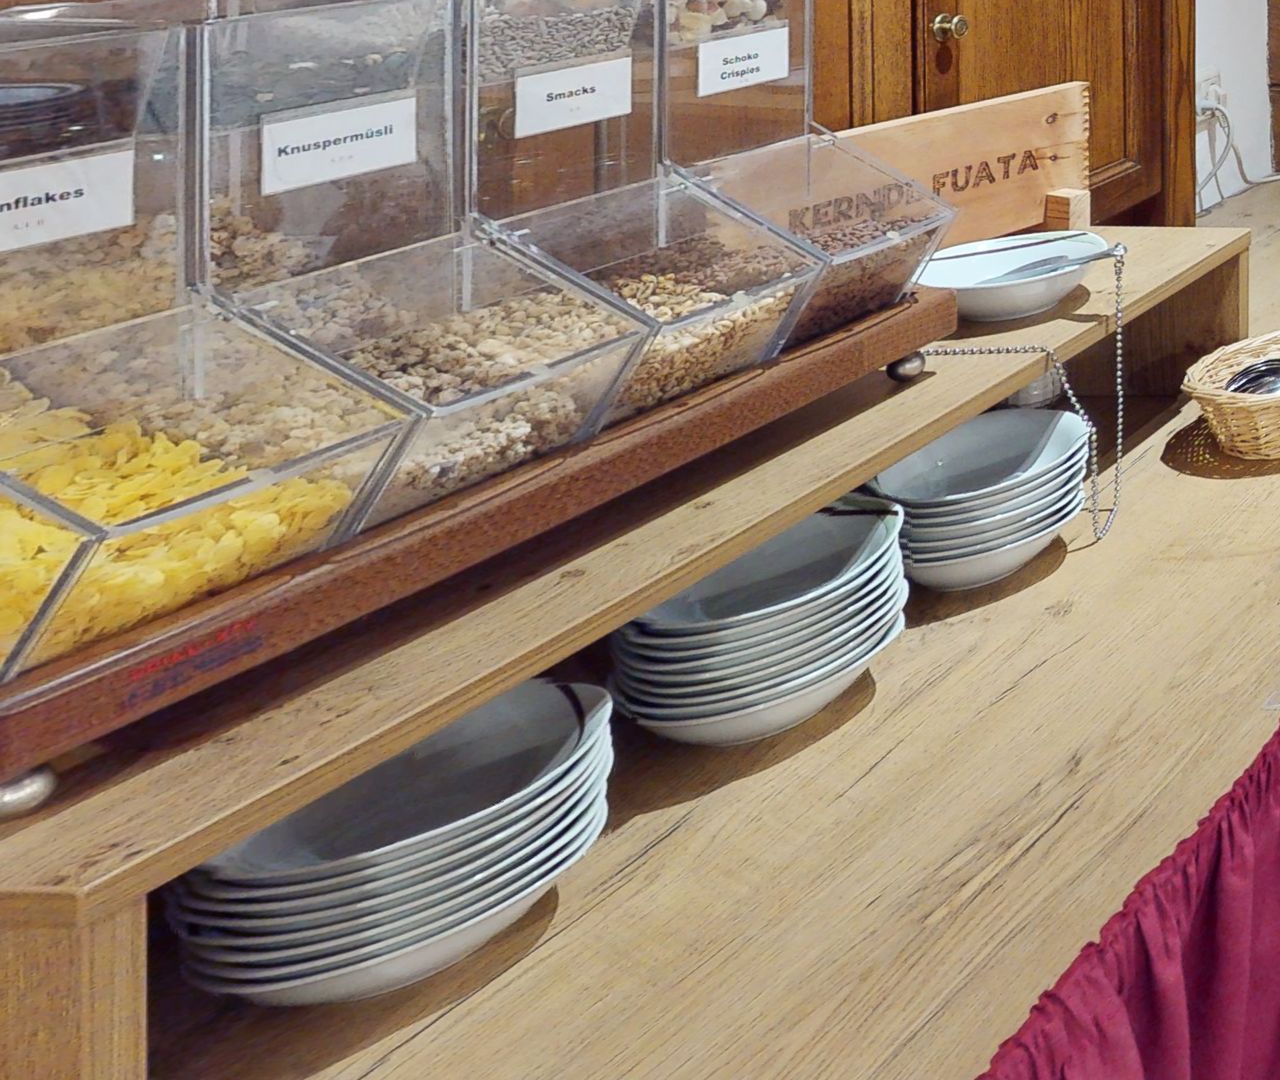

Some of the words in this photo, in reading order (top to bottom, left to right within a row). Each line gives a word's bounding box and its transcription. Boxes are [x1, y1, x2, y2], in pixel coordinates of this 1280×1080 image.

[722, 52, 759, 66] Schoko
[720, 66, 760, 80] Crispies
[546, 85, 596, 102] Smacks
[277, 124, 394, 157] Knuspermüsli
[932, 149, 1039, 196] FUATA
